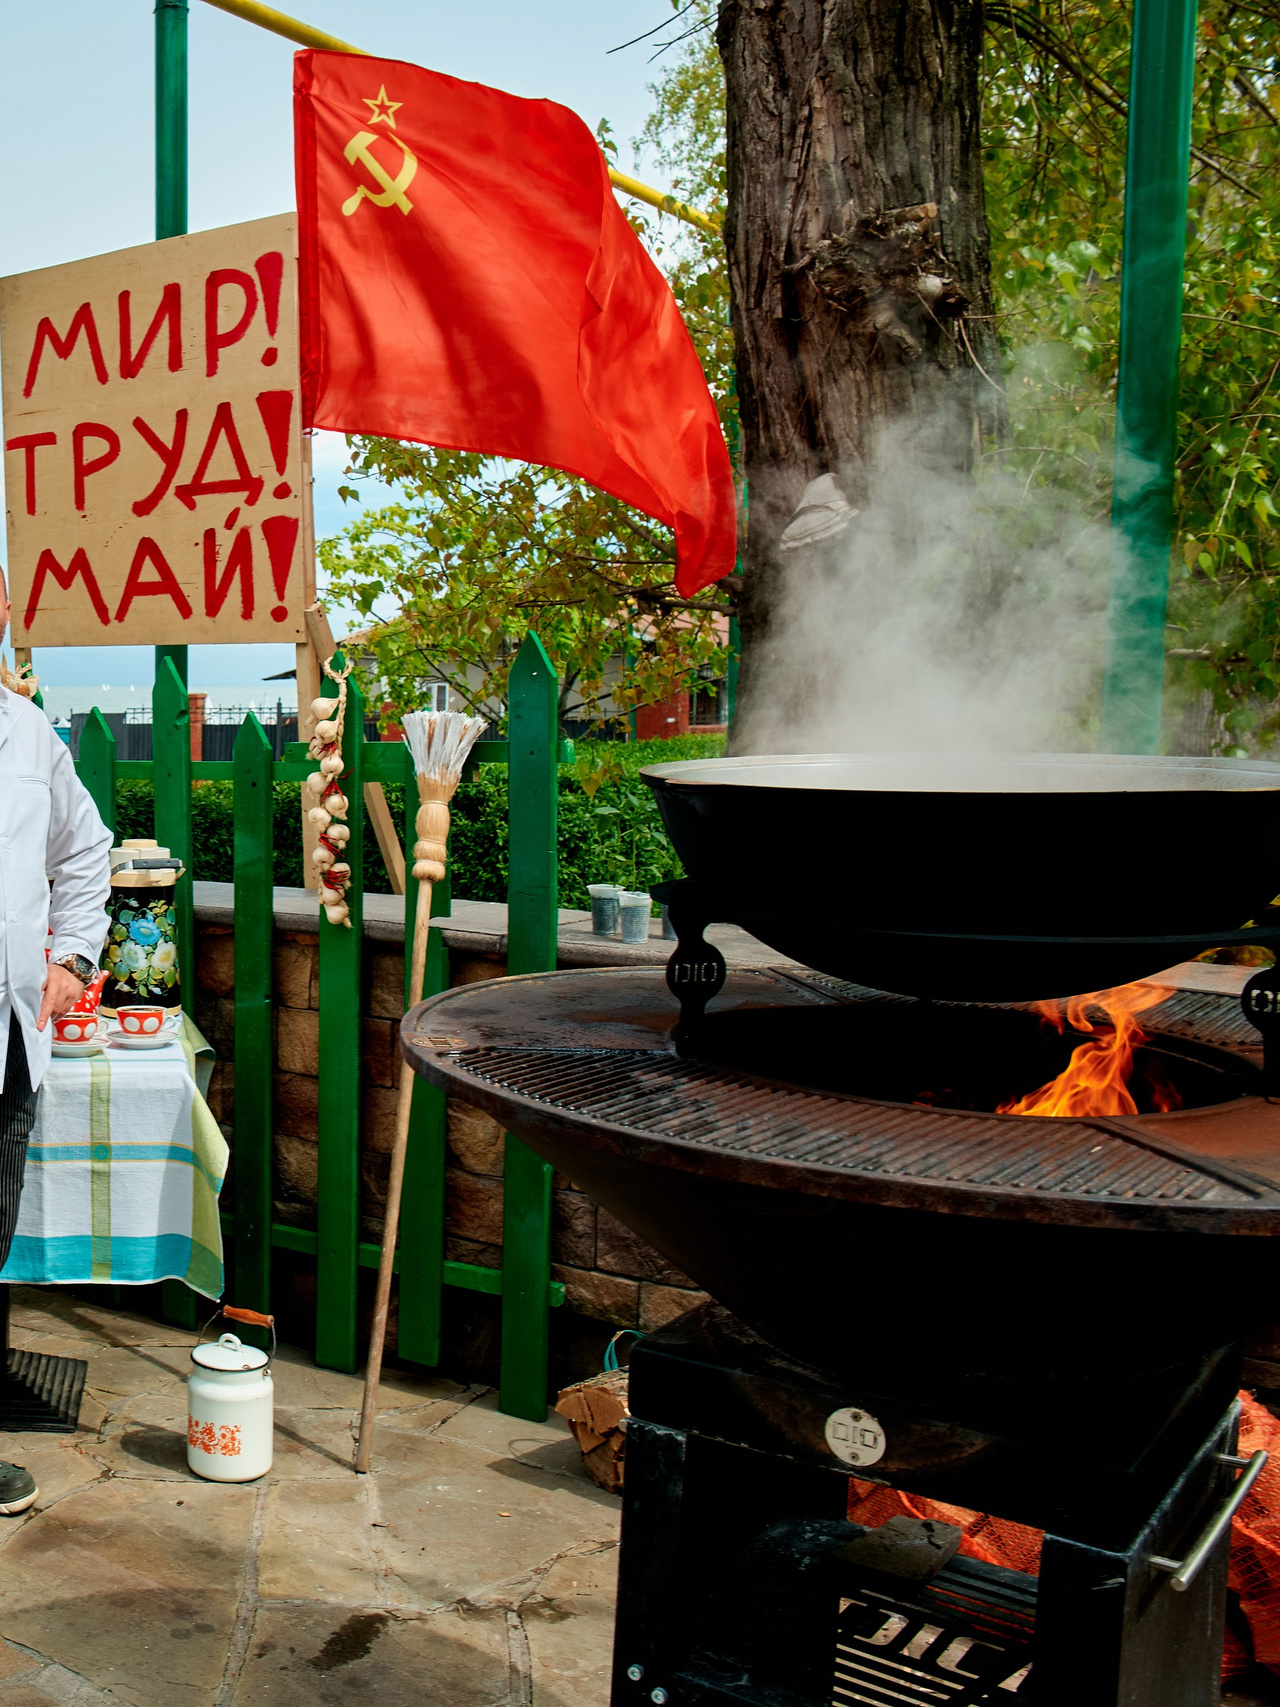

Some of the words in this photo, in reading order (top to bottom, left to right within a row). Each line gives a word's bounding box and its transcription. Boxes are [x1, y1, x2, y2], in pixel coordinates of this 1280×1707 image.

[23, 251, 285, 398] МИР!
[6, 389, 294, 517] ТРУД!
[24, 506, 299, 634] МАЙ!
